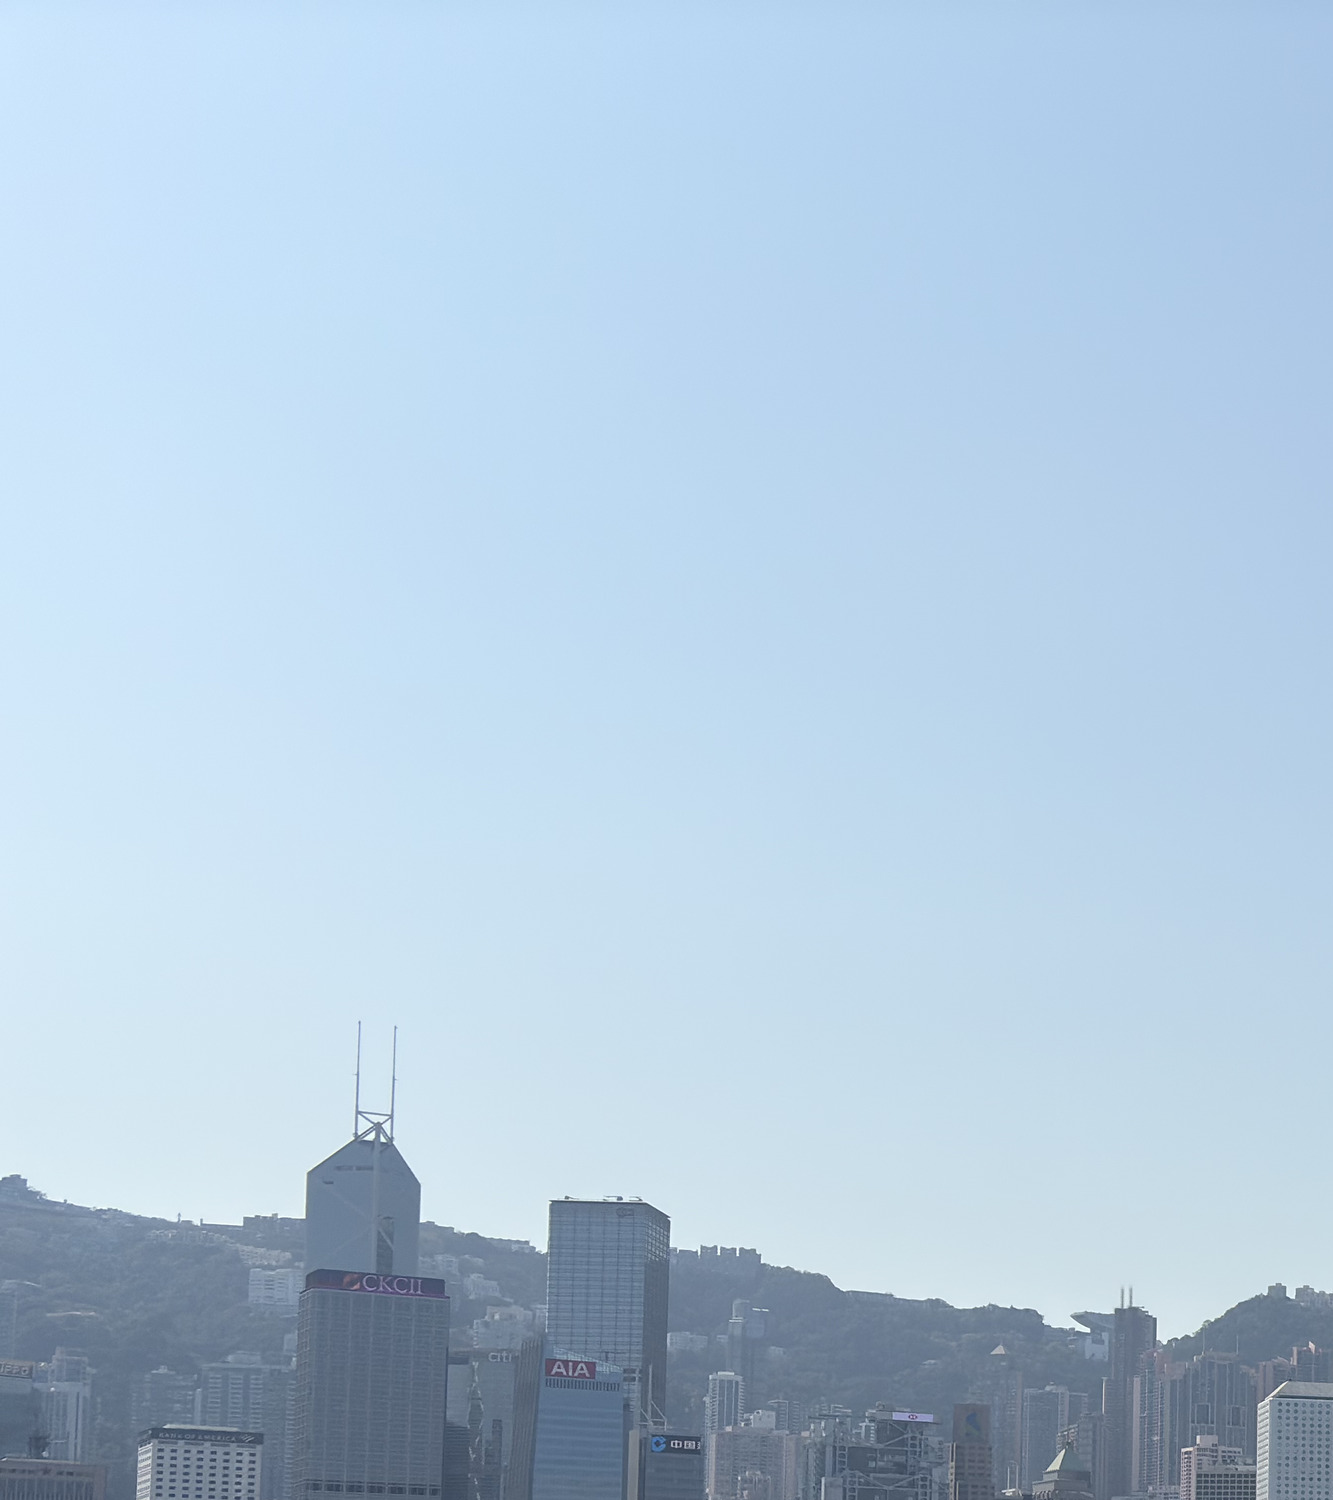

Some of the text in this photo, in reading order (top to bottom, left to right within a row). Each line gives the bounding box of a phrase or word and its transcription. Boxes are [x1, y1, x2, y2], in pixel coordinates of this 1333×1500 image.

[487, 1351, 513, 1363] citi
[550, 1361, 590, 1378] AIA
[158, 1432, 184, 1440] BANK
[197, 1434, 237, 1442] AMERICA
[670, 1439, 700, 1450] 中国
